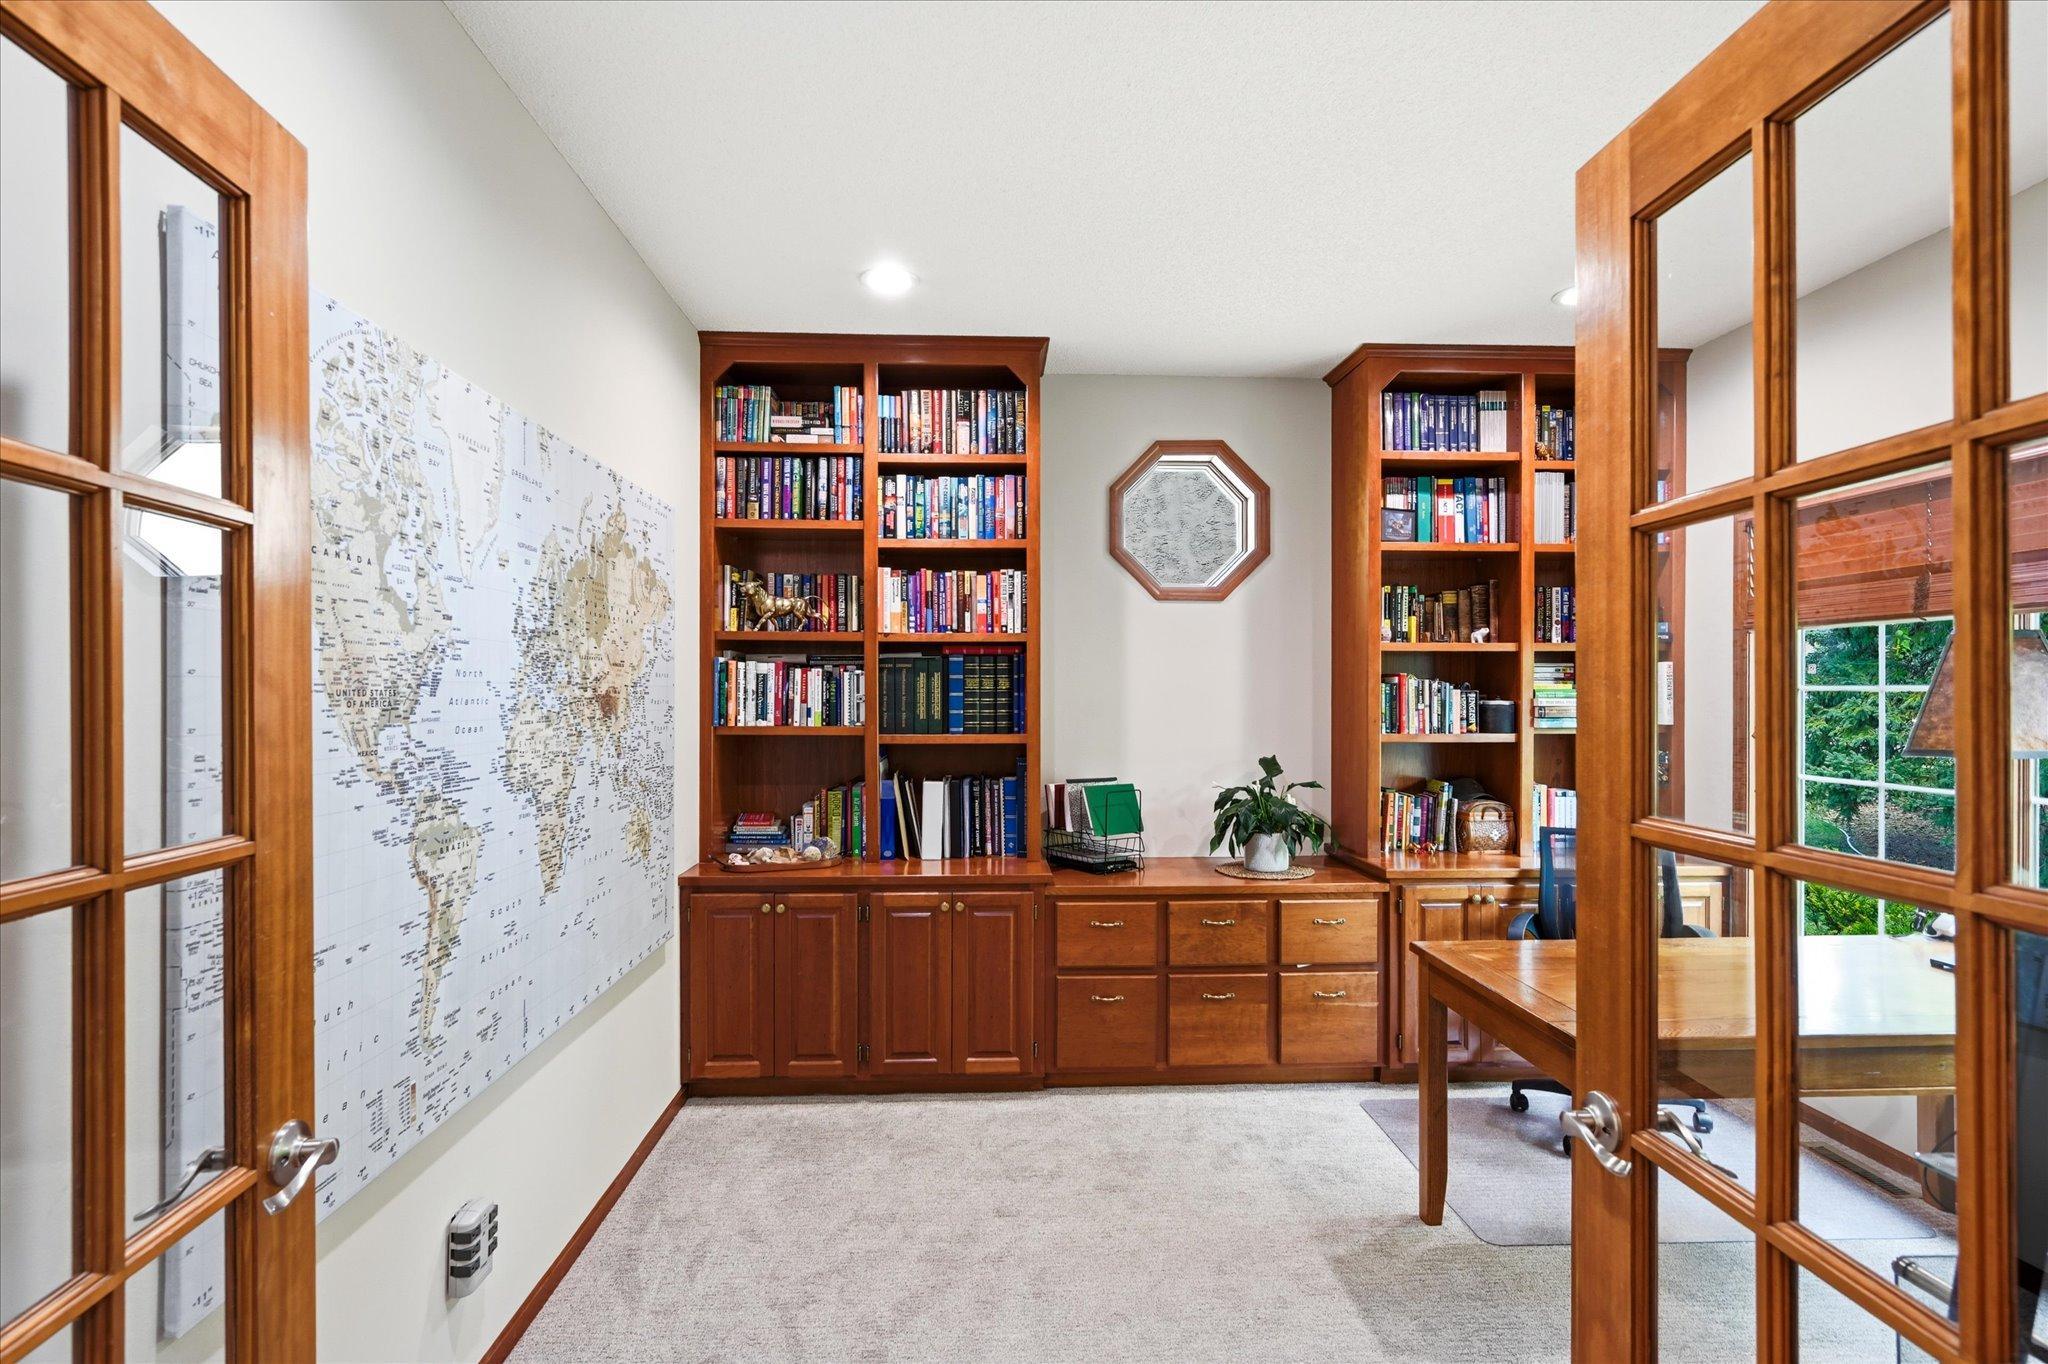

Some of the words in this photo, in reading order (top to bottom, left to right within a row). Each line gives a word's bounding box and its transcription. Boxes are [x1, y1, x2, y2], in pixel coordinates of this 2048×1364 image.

[188, 357, 220, 374] CHUKCH
[198, 377, 212, 388] SEA
[424, 442, 445, 455] BAFFIN
[428, 458, 440, 467] BAY
[1456, 496, 1464, 515] ACT
[312, 545, 372, 566] CANADA
[456, 669, 483, 677] North
[336, 689, 367, 697] UNITED
[359, 700, 393, 708] AMERICA
[448, 697, 489, 706] Atlantic
[454, 726, 484, 735] Ocean
[358, 749, 378, 757] MEXICO
[439, 842, 470, 854] BRAZIL
[490, 899, 522, 918] South
[480, 933, 530, 964] Atlantic
[490, 975, 523, 1000] Ocean
[324, 1000, 354, 1022] uth
[327, 1034, 379, 1070] ific
[322, 1090, 366, 1123] ean
